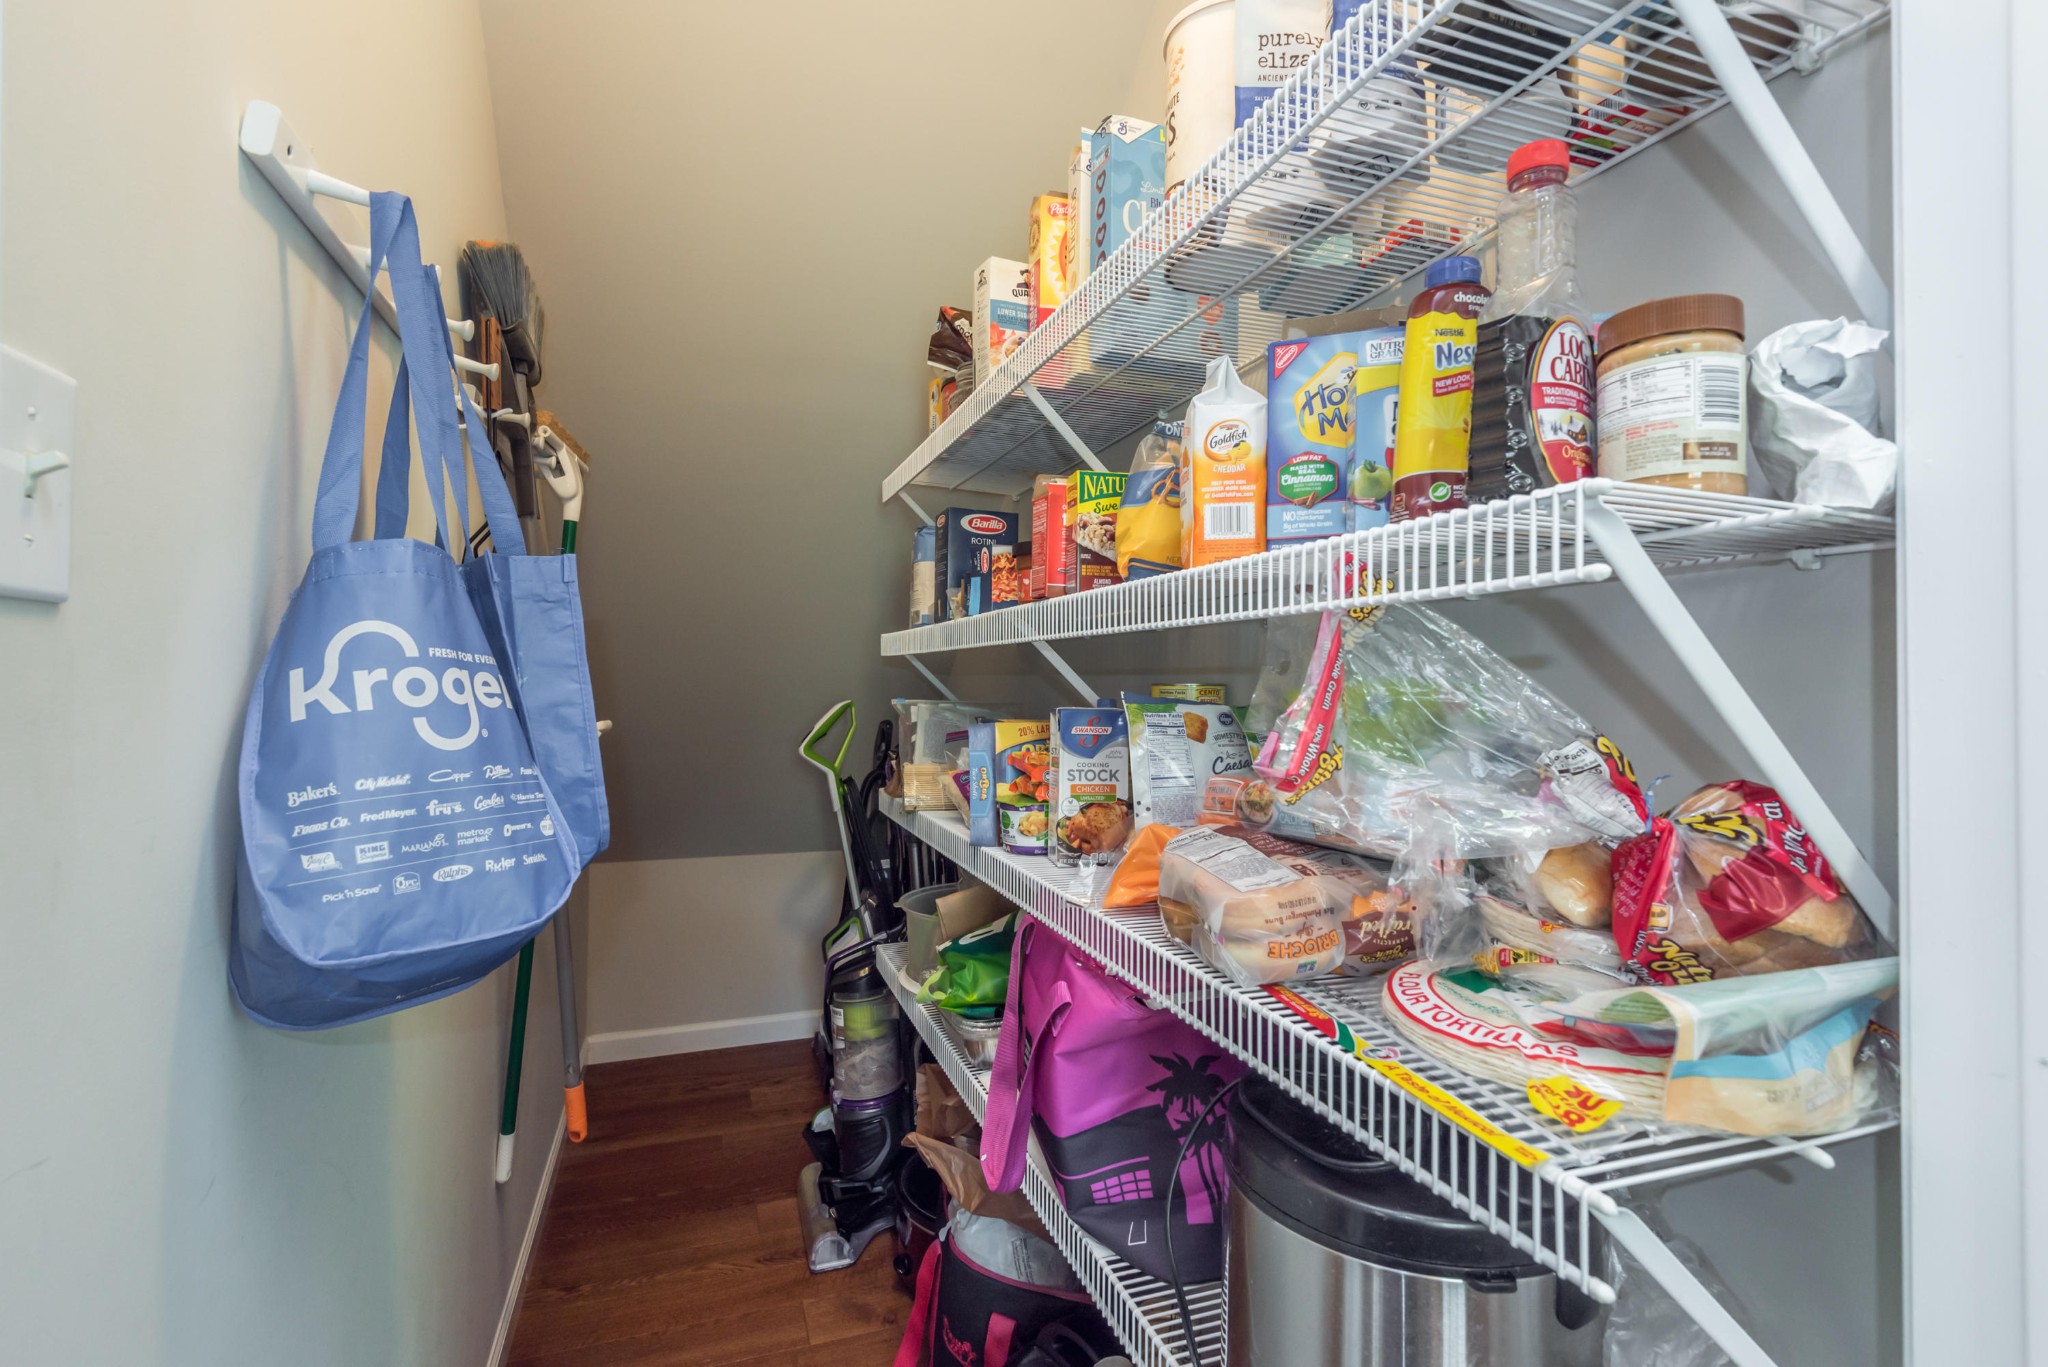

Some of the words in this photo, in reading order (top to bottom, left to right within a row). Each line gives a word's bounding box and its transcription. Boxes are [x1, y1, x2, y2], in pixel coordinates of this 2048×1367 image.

[1258, 33, 1324, 51] purely
[1558, 332, 1588, 363] LOG
[1436, 378, 1452, 388] NEW
[1453, 374, 1471, 384] LOOK
[1542, 386, 1580, 400] TRADITIONAL
[1210, 429, 1247, 449] Goldfish
[1293, 455, 1308, 463] LOW
[1213, 464, 1246, 473] CHEDDAR
[1281, 474, 1334, 485] Cinnamon
[1283, 511, 1296, 522] NO
[972, 518, 1003, 530] Barilla
[971, 537, 997, 545] ROTINI
[428, 647, 457, 659] FRESH
[458, 652, 473, 662] FOR
[1321, 679, 1337, 710] Grain
[1018, 727, 1035, 737] 20%
[1299, 742, 1321, 777] Whole
[1067, 769, 1120, 783] STOCK
[287, 782, 338, 808] Baker's
[1076, 785, 1111, 793] CHICKEN
[360, 811, 385, 822] Fred
[457, 828, 484, 838] metro
[457, 835, 489, 846] market
[437, 865, 470, 881] Ralphs
[322, 893, 345, 903] Pick
[354, 887, 379, 897] Save
[1268, 929, 1340, 960] BRIOCHE
[1398, 971, 1430, 1006] FLOUR
[1421, 1003, 1579, 1058] TORTILLAS
